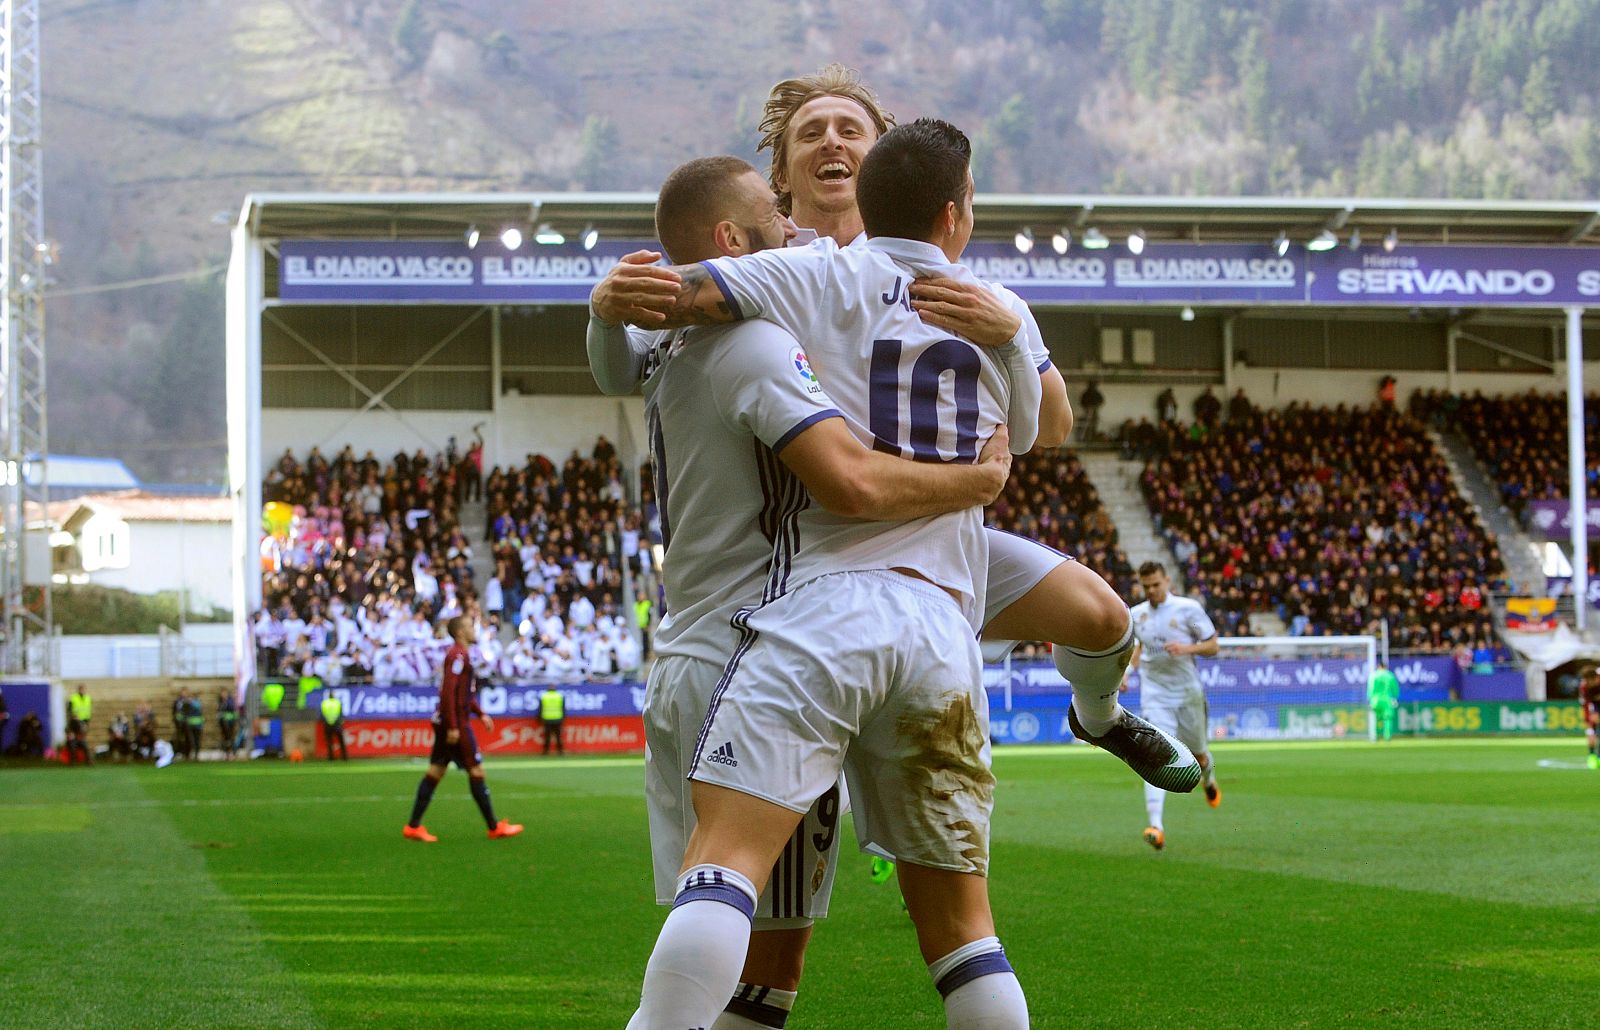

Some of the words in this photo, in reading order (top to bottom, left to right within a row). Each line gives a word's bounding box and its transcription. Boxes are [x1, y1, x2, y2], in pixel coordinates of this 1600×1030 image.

[285, 256, 312, 276] EL
[315, 256, 395, 276] DIARIO
[397, 257, 474, 278] VASCO
[481, 256, 510, 276] EL
[511, 256, 591, 276] DIARIO
[960, 257, 1028, 277] IARIO
[1030, 258, 1105, 278] VASCO
[1114, 258, 1141, 279] EL
[1142, 258, 1219, 279] DIARIO
[1221, 258, 1295, 279] VASCO
[1337, 268, 1555, 295] SERVANDO
[869, 339, 982, 464] 10
[1287, 709, 1366, 732] bet36
[706, 753, 738, 768] adidas
[813, 786, 840, 852] 9
